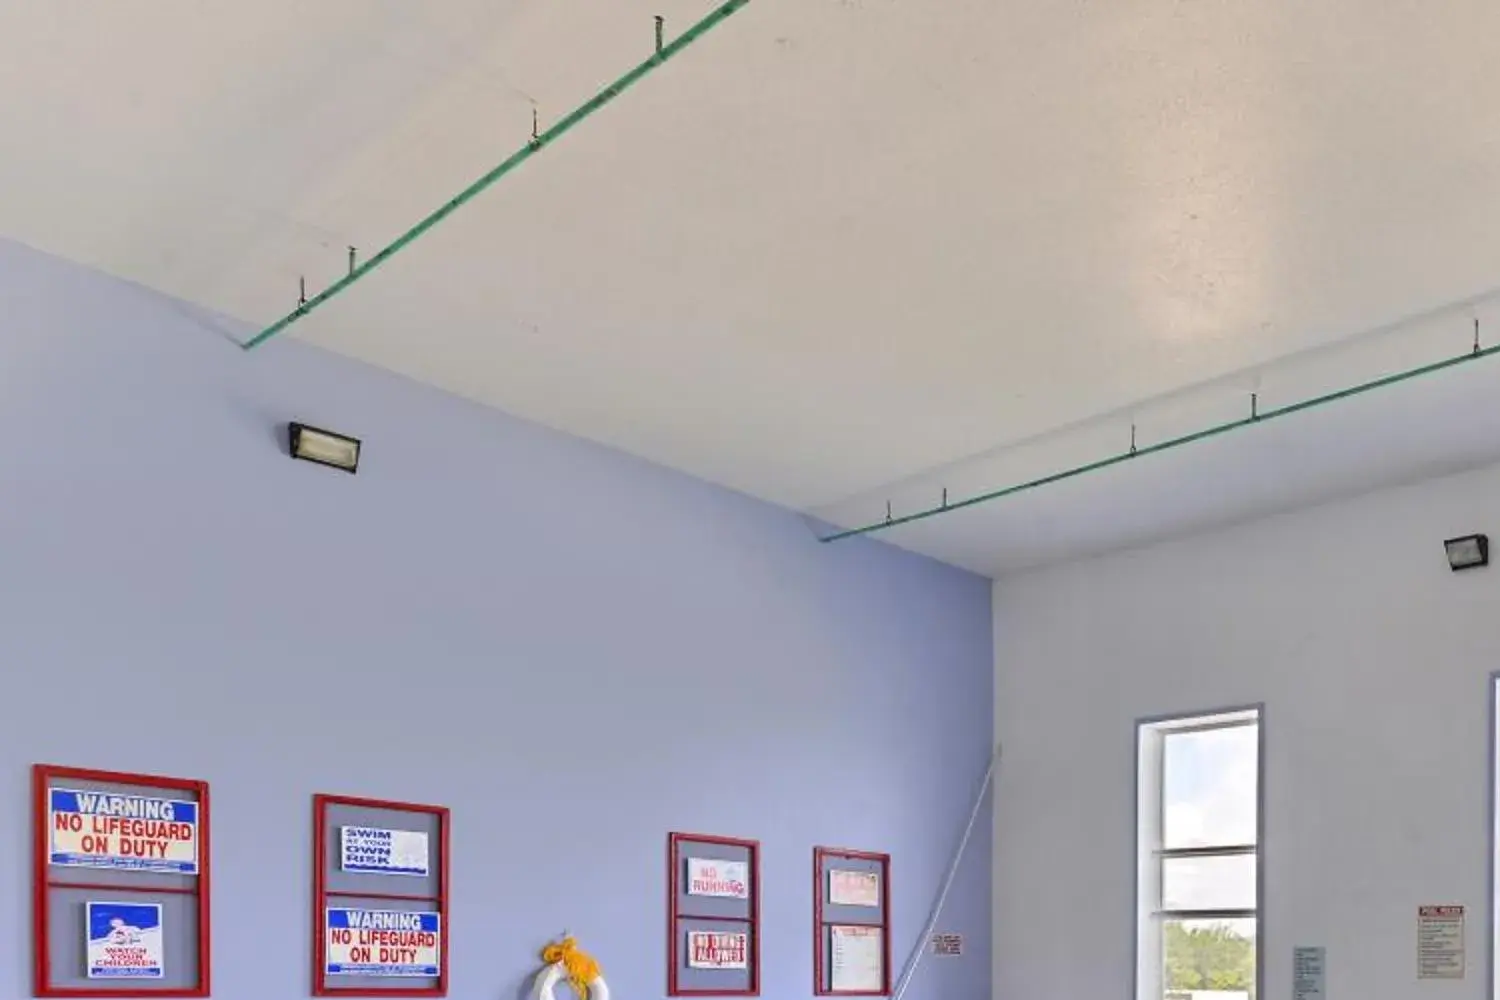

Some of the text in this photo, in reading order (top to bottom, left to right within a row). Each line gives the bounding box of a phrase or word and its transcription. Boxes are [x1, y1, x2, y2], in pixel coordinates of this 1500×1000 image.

[76, 793, 174, 820] WARNING
[55, 814, 192, 840] NO LIFEGUARD
[346, 828, 391, 839] SWIM
[81, 836, 168, 858] ON DUTY
[346, 846, 391, 856] OWN
[346, 854, 390, 865] RISK
[693, 880, 744, 893] RUNNING
[346, 912, 421, 930] WARNING
[332, 929, 434, 947] NO LIFEGUARD
[105, 947, 147, 955] WATCH
[350, 947, 417, 963] ON DUTY
